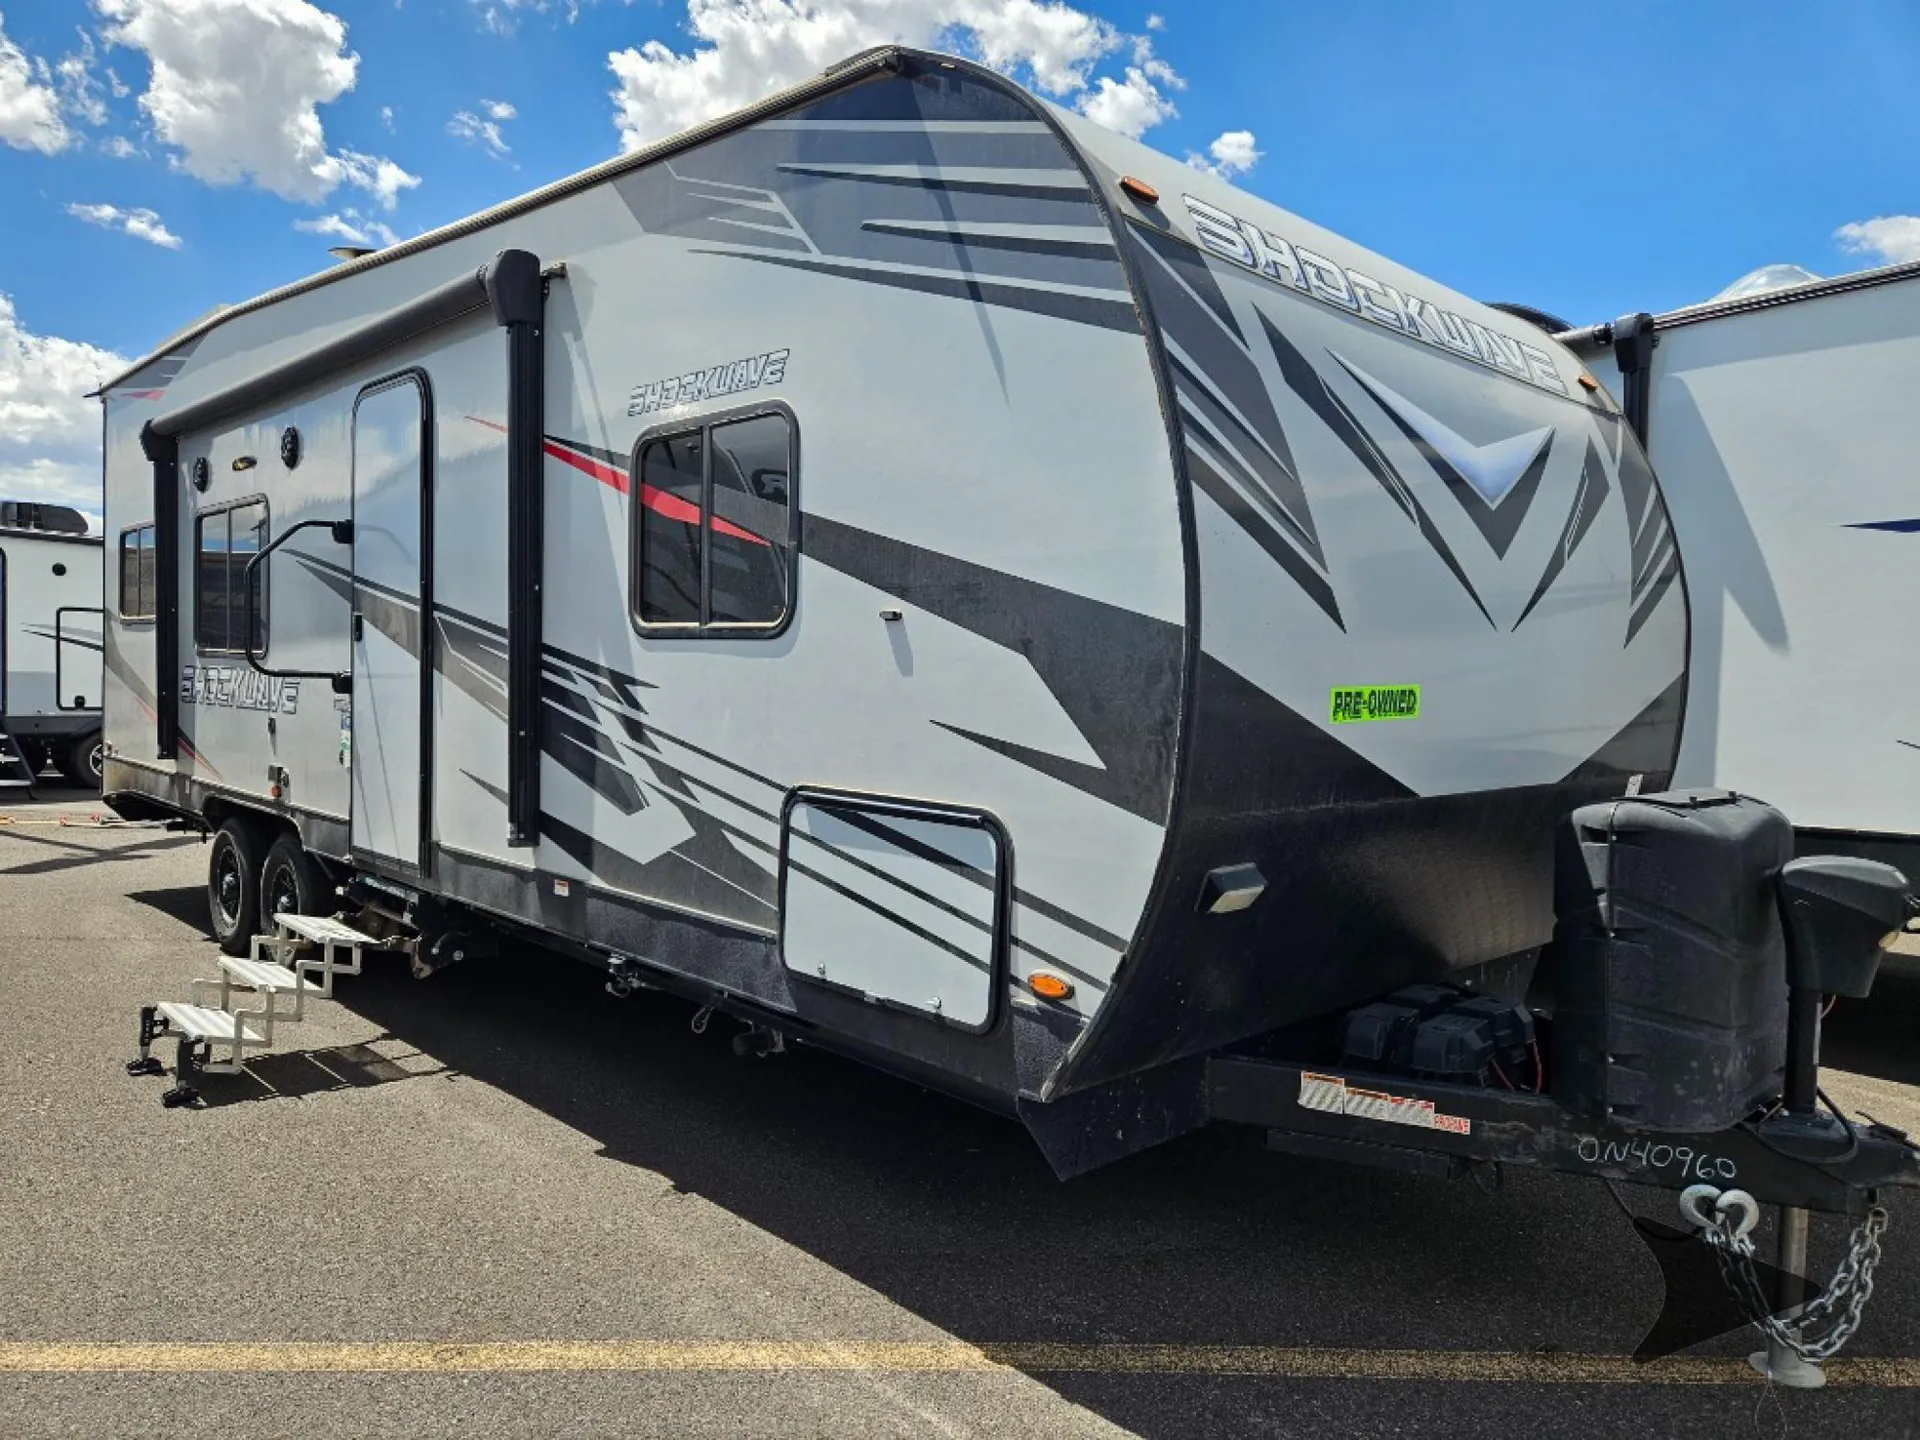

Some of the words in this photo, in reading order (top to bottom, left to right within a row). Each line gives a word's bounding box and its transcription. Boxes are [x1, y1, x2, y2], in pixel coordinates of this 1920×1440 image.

[1182, 193, 1569, 397] SHOCKWAVE
[628, 348, 790, 416] SHOCKWAVE
[178, 664, 300, 714] SHOCKWAVE
[1333, 689, 1416, 720] PRE-OWNED
